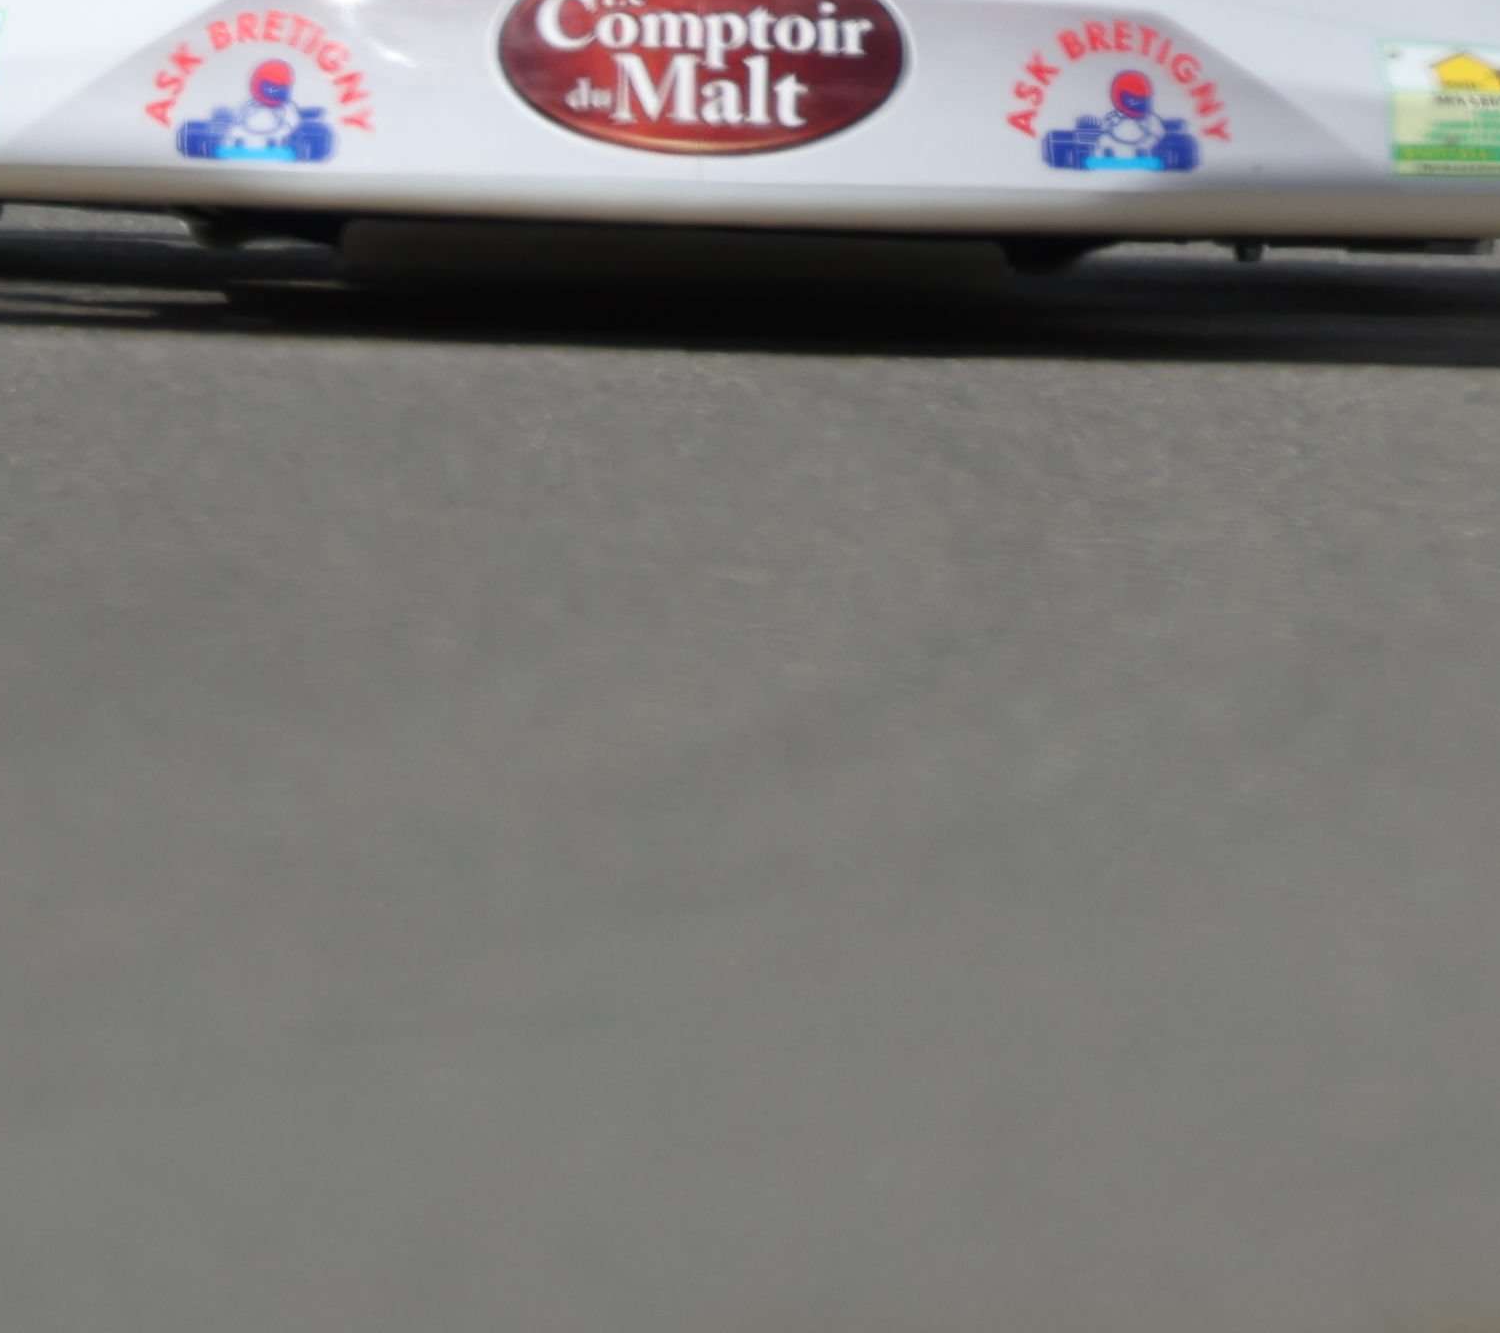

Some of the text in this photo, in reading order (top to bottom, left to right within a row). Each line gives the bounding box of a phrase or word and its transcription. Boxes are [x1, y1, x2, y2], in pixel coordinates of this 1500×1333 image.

[144, 9, 375, 131] ASK BRETIGNY
[565, 51, 809, 128] du Malt
[1004, 18, 1232, 144] ASK BRETIGNY
